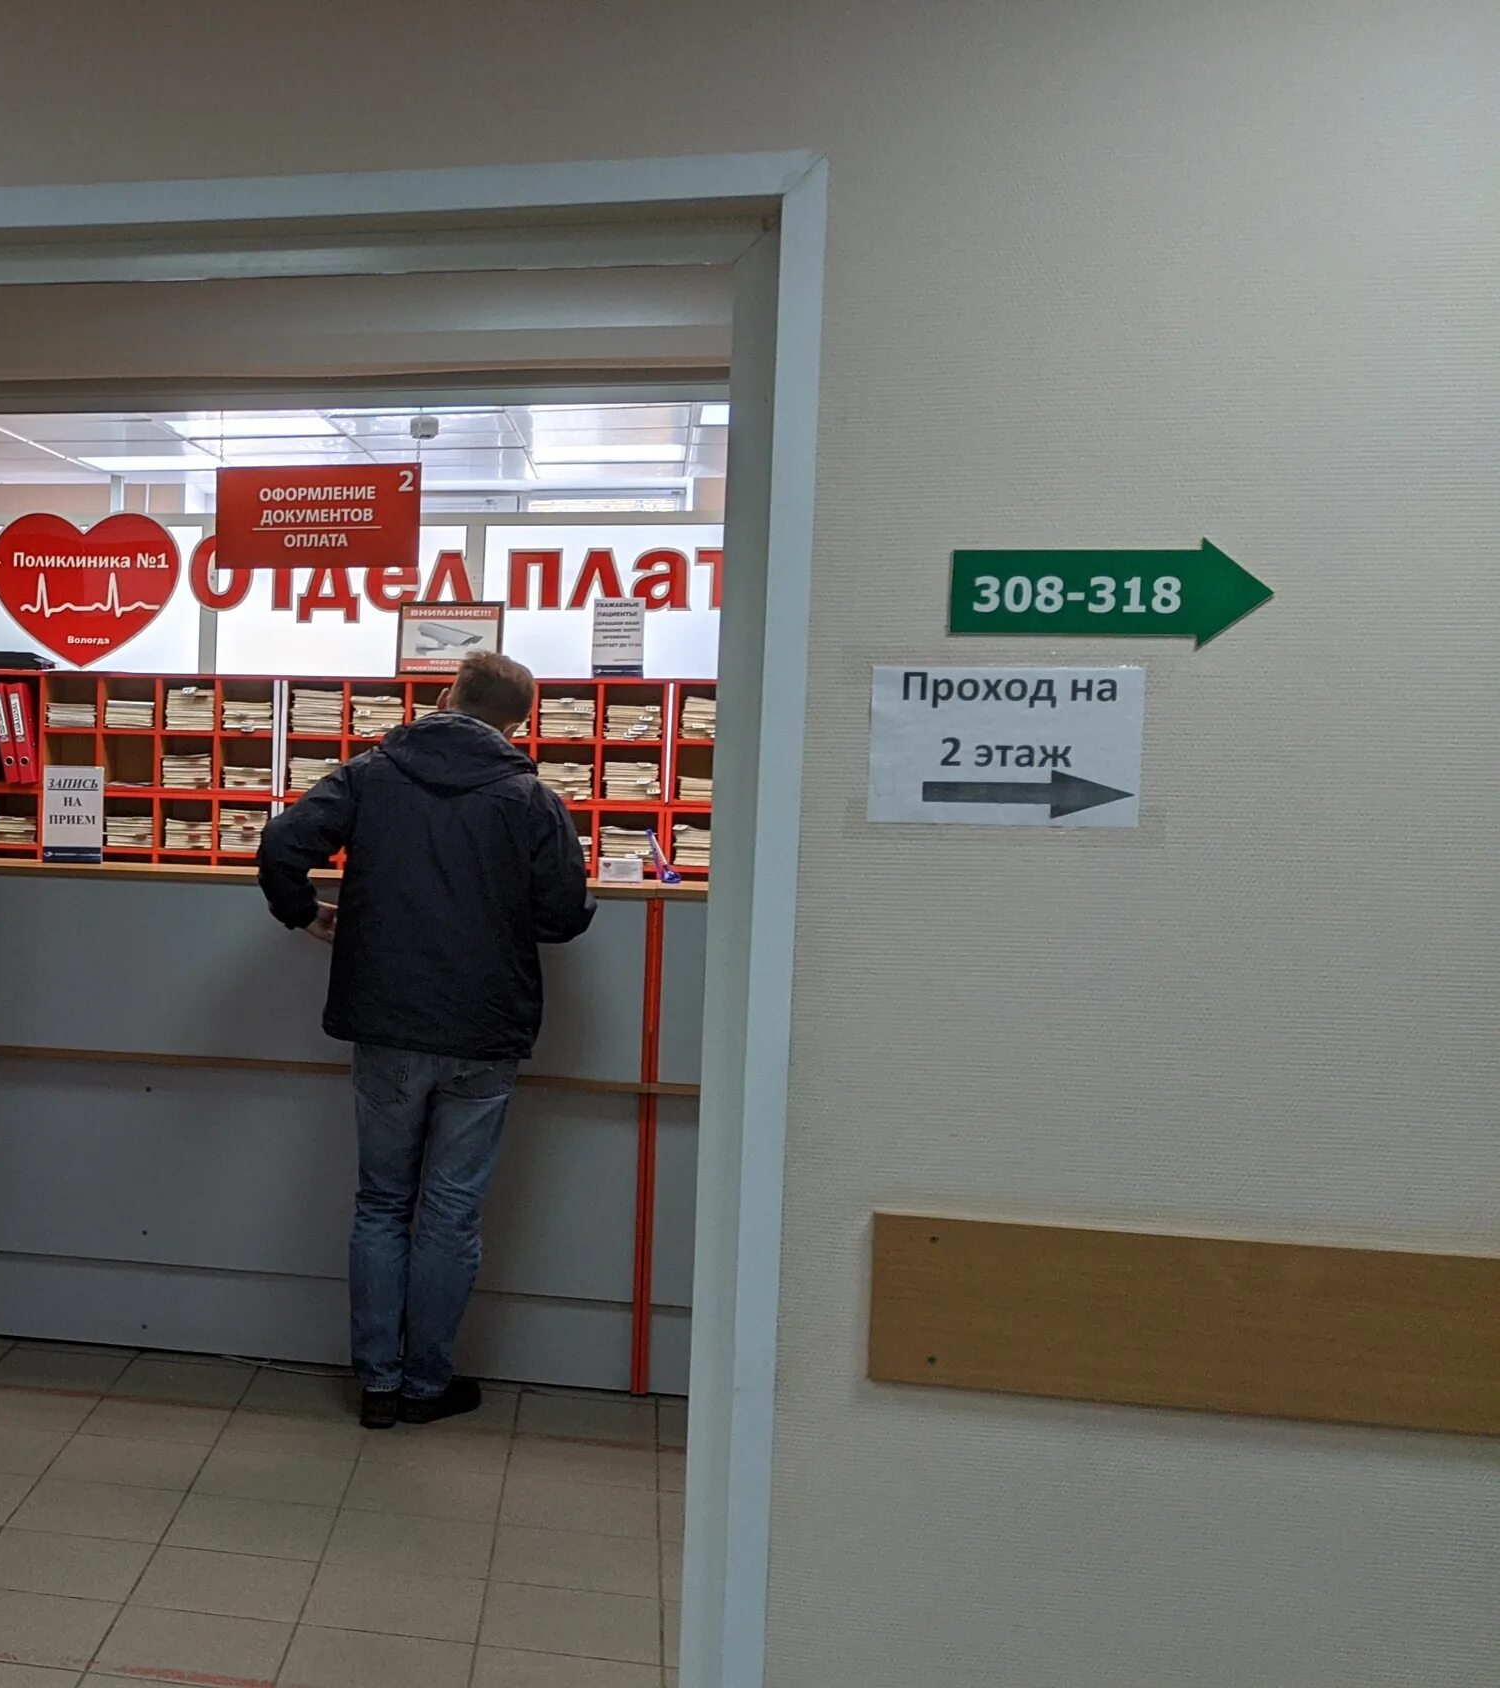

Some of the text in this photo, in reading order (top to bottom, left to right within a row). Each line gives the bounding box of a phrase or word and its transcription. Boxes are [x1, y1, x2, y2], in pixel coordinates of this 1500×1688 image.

[398, 470, 414, 492] 2
[259, 485, 376, 502] ОФОРМЛЕНИЕ
[260, 508, 374, 526] ДОКУМЕНТОВ
[284, 533, 348, 549] ОПЛАТА
[13, 552, 169, 569] Поликлиника №1
[972, 575, 1182, 614] 308-318
[67, 635, 110, 645] Вологда
[902, 671, 1119, 708] Проход на
[940, 738, 1072, 768] 2 этаж
[48, 778, 99, 790] ЗАПИСЬ
[63, 797, 82, 807] НА
[49, 814, 96, 825] ПРИЕМ
